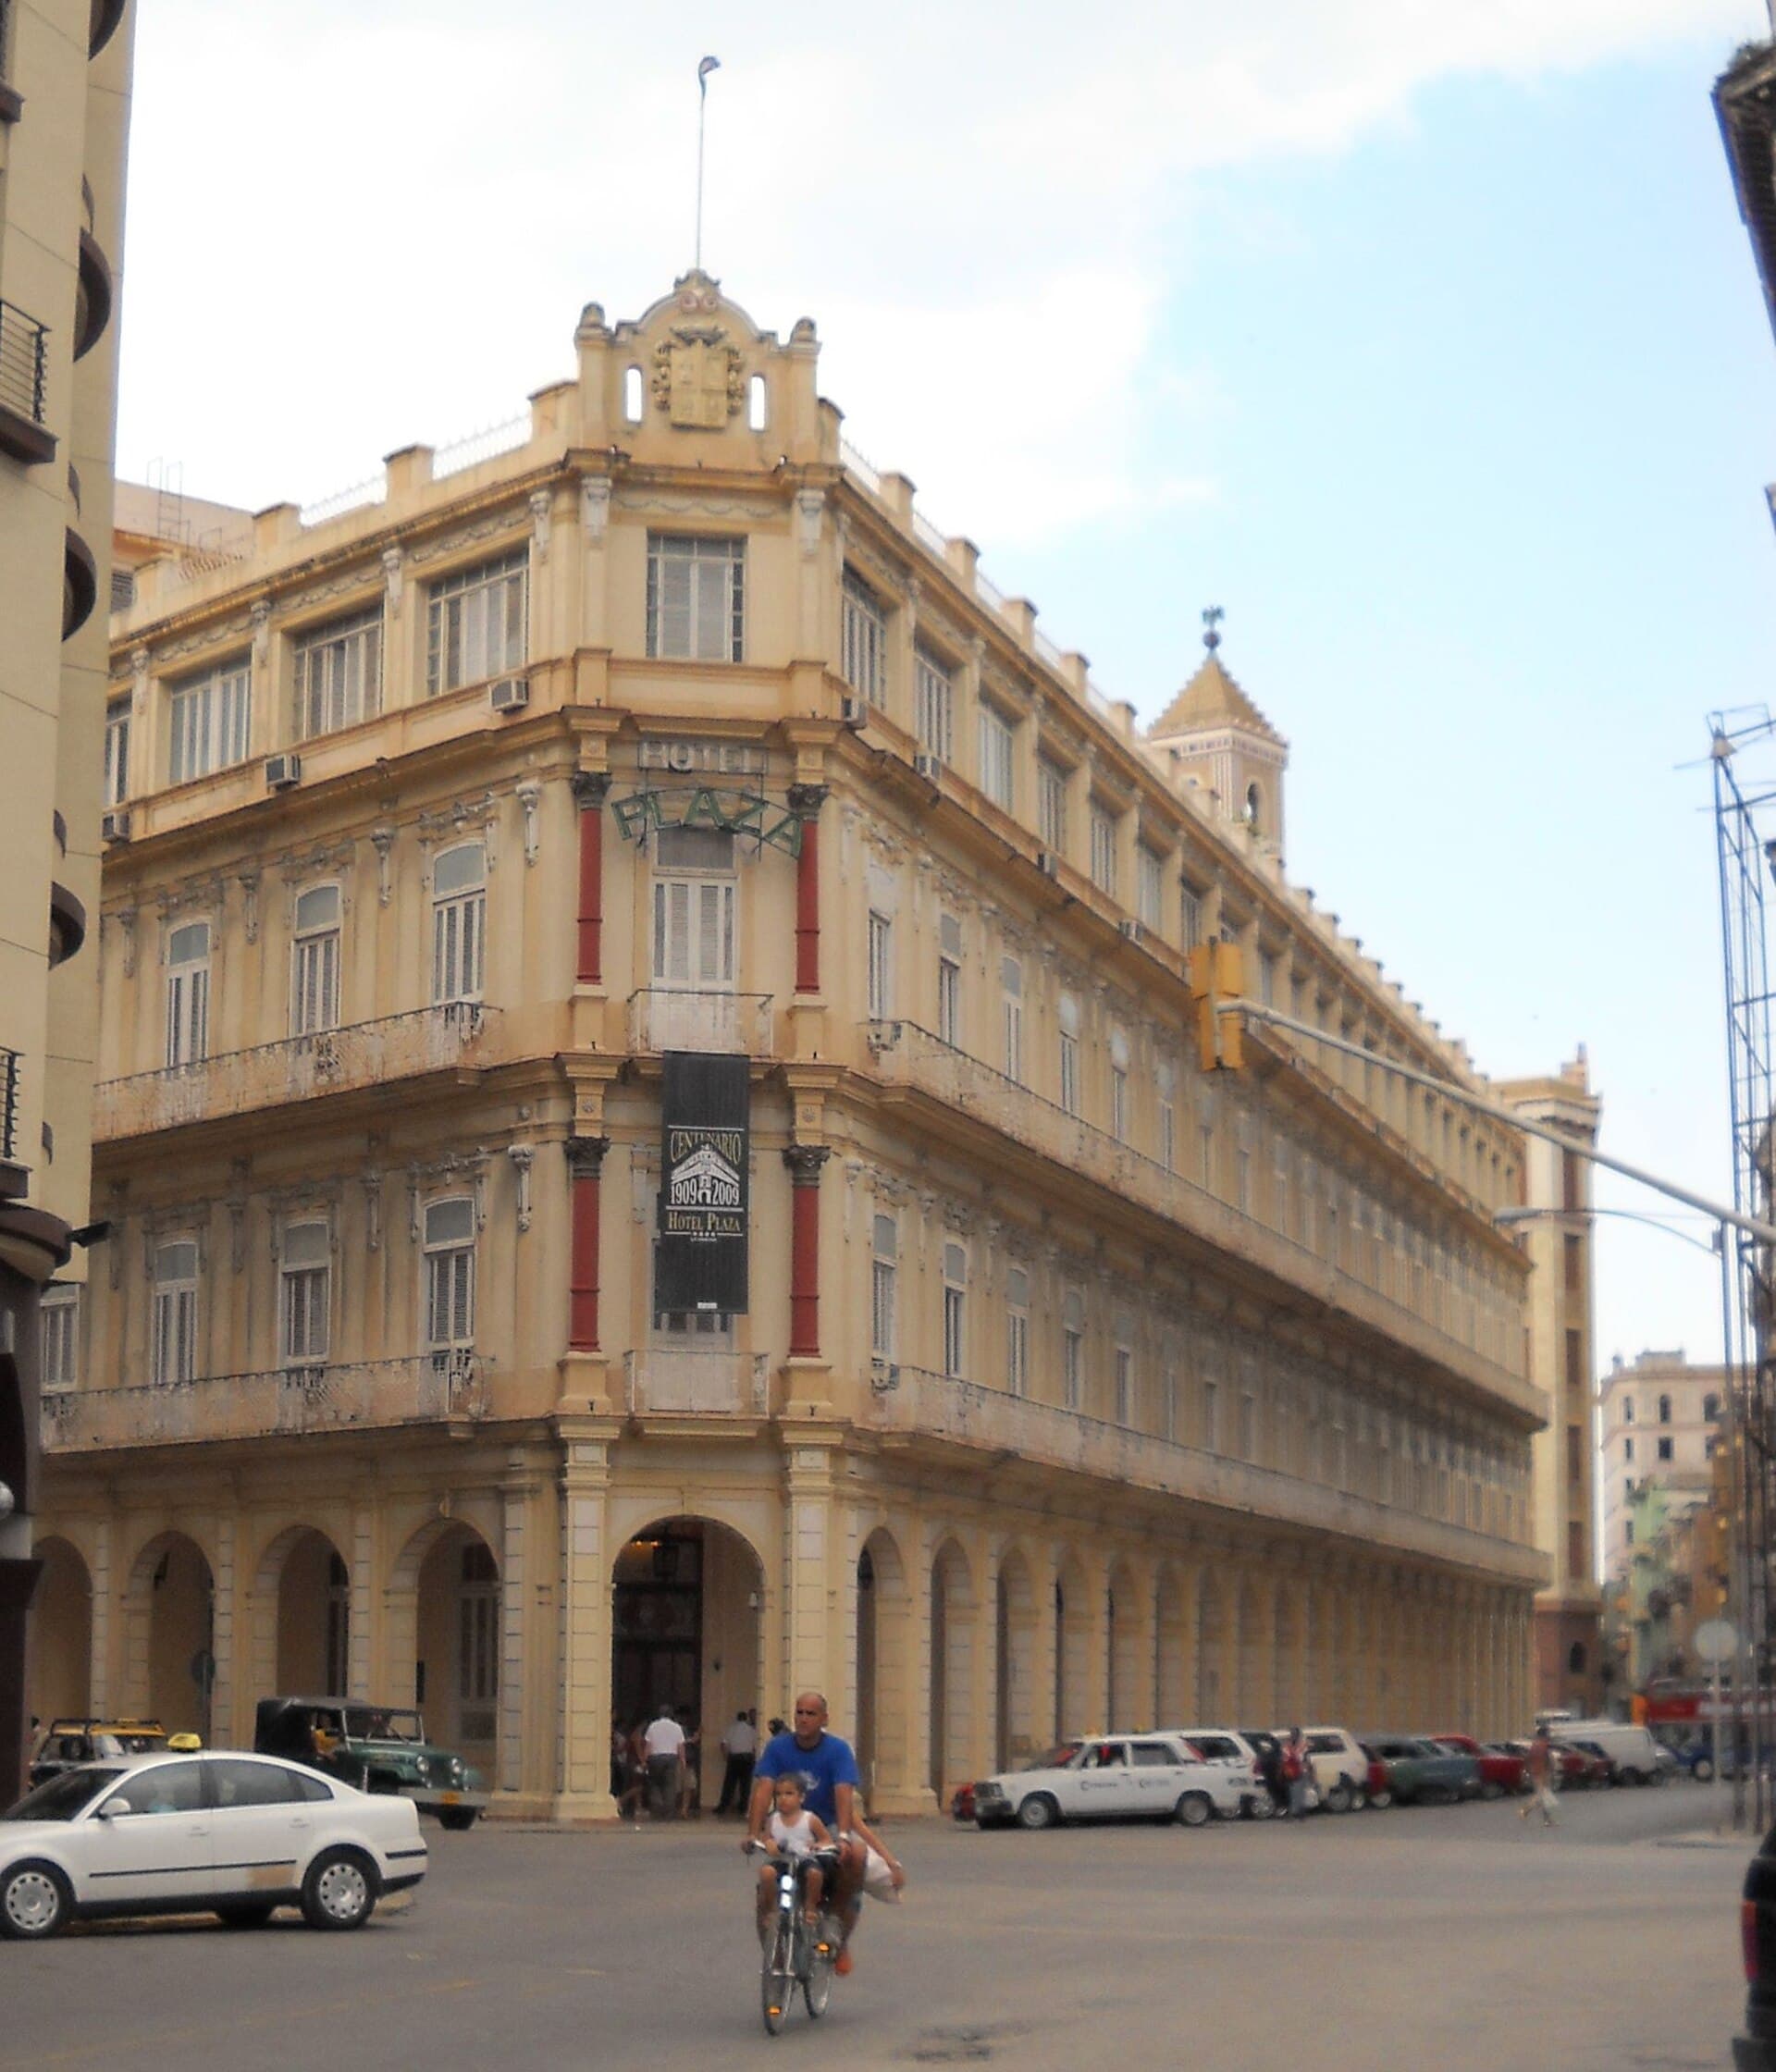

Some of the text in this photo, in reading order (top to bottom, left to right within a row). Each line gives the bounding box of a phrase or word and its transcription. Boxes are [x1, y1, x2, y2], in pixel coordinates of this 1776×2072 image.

[611, 788, 802, 859] PLAZA
[671, 1131, 742, 1165] CENTENARIO
[671, 1178, 740, 1206] 1909 2009
[669, 1211, 740, 1232] HOTEL PLAZA
